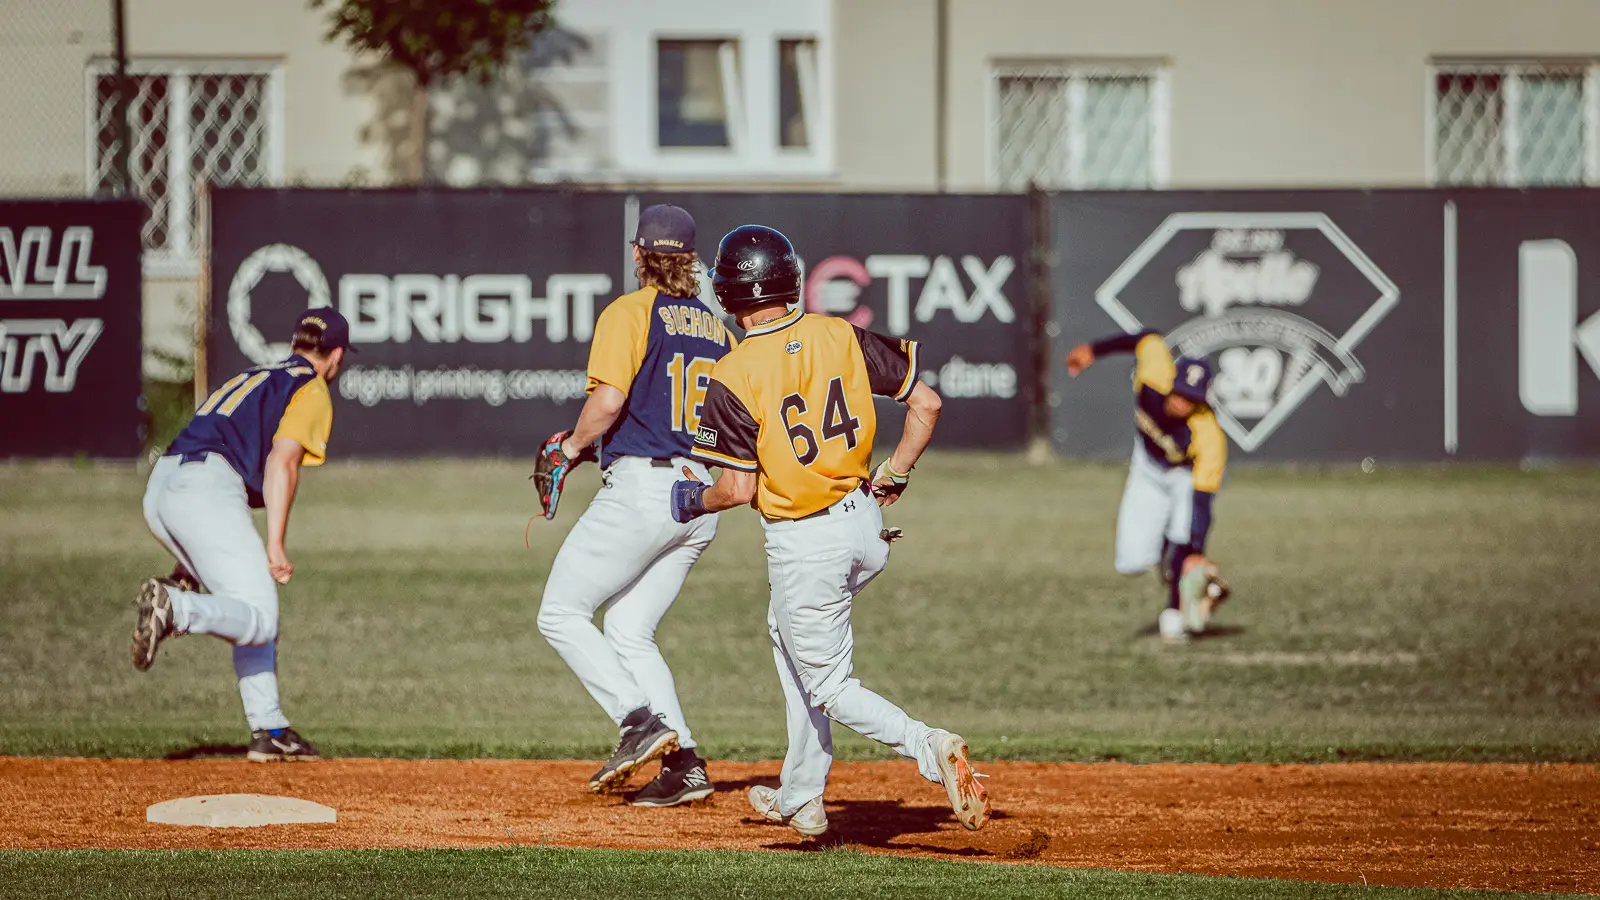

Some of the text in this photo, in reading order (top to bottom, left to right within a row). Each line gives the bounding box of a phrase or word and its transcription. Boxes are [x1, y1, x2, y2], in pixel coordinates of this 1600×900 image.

[338, 273, 613, 344] BRIGHT
[658, 305, 726, 347] SUCHON
[196, 370, 271, 417] 11
[339, 363, 415, 407] digital
[414, 363, 507, 407] printing
[667, 352, 717, 435] 16
[779, 375, 861, 468] 64
